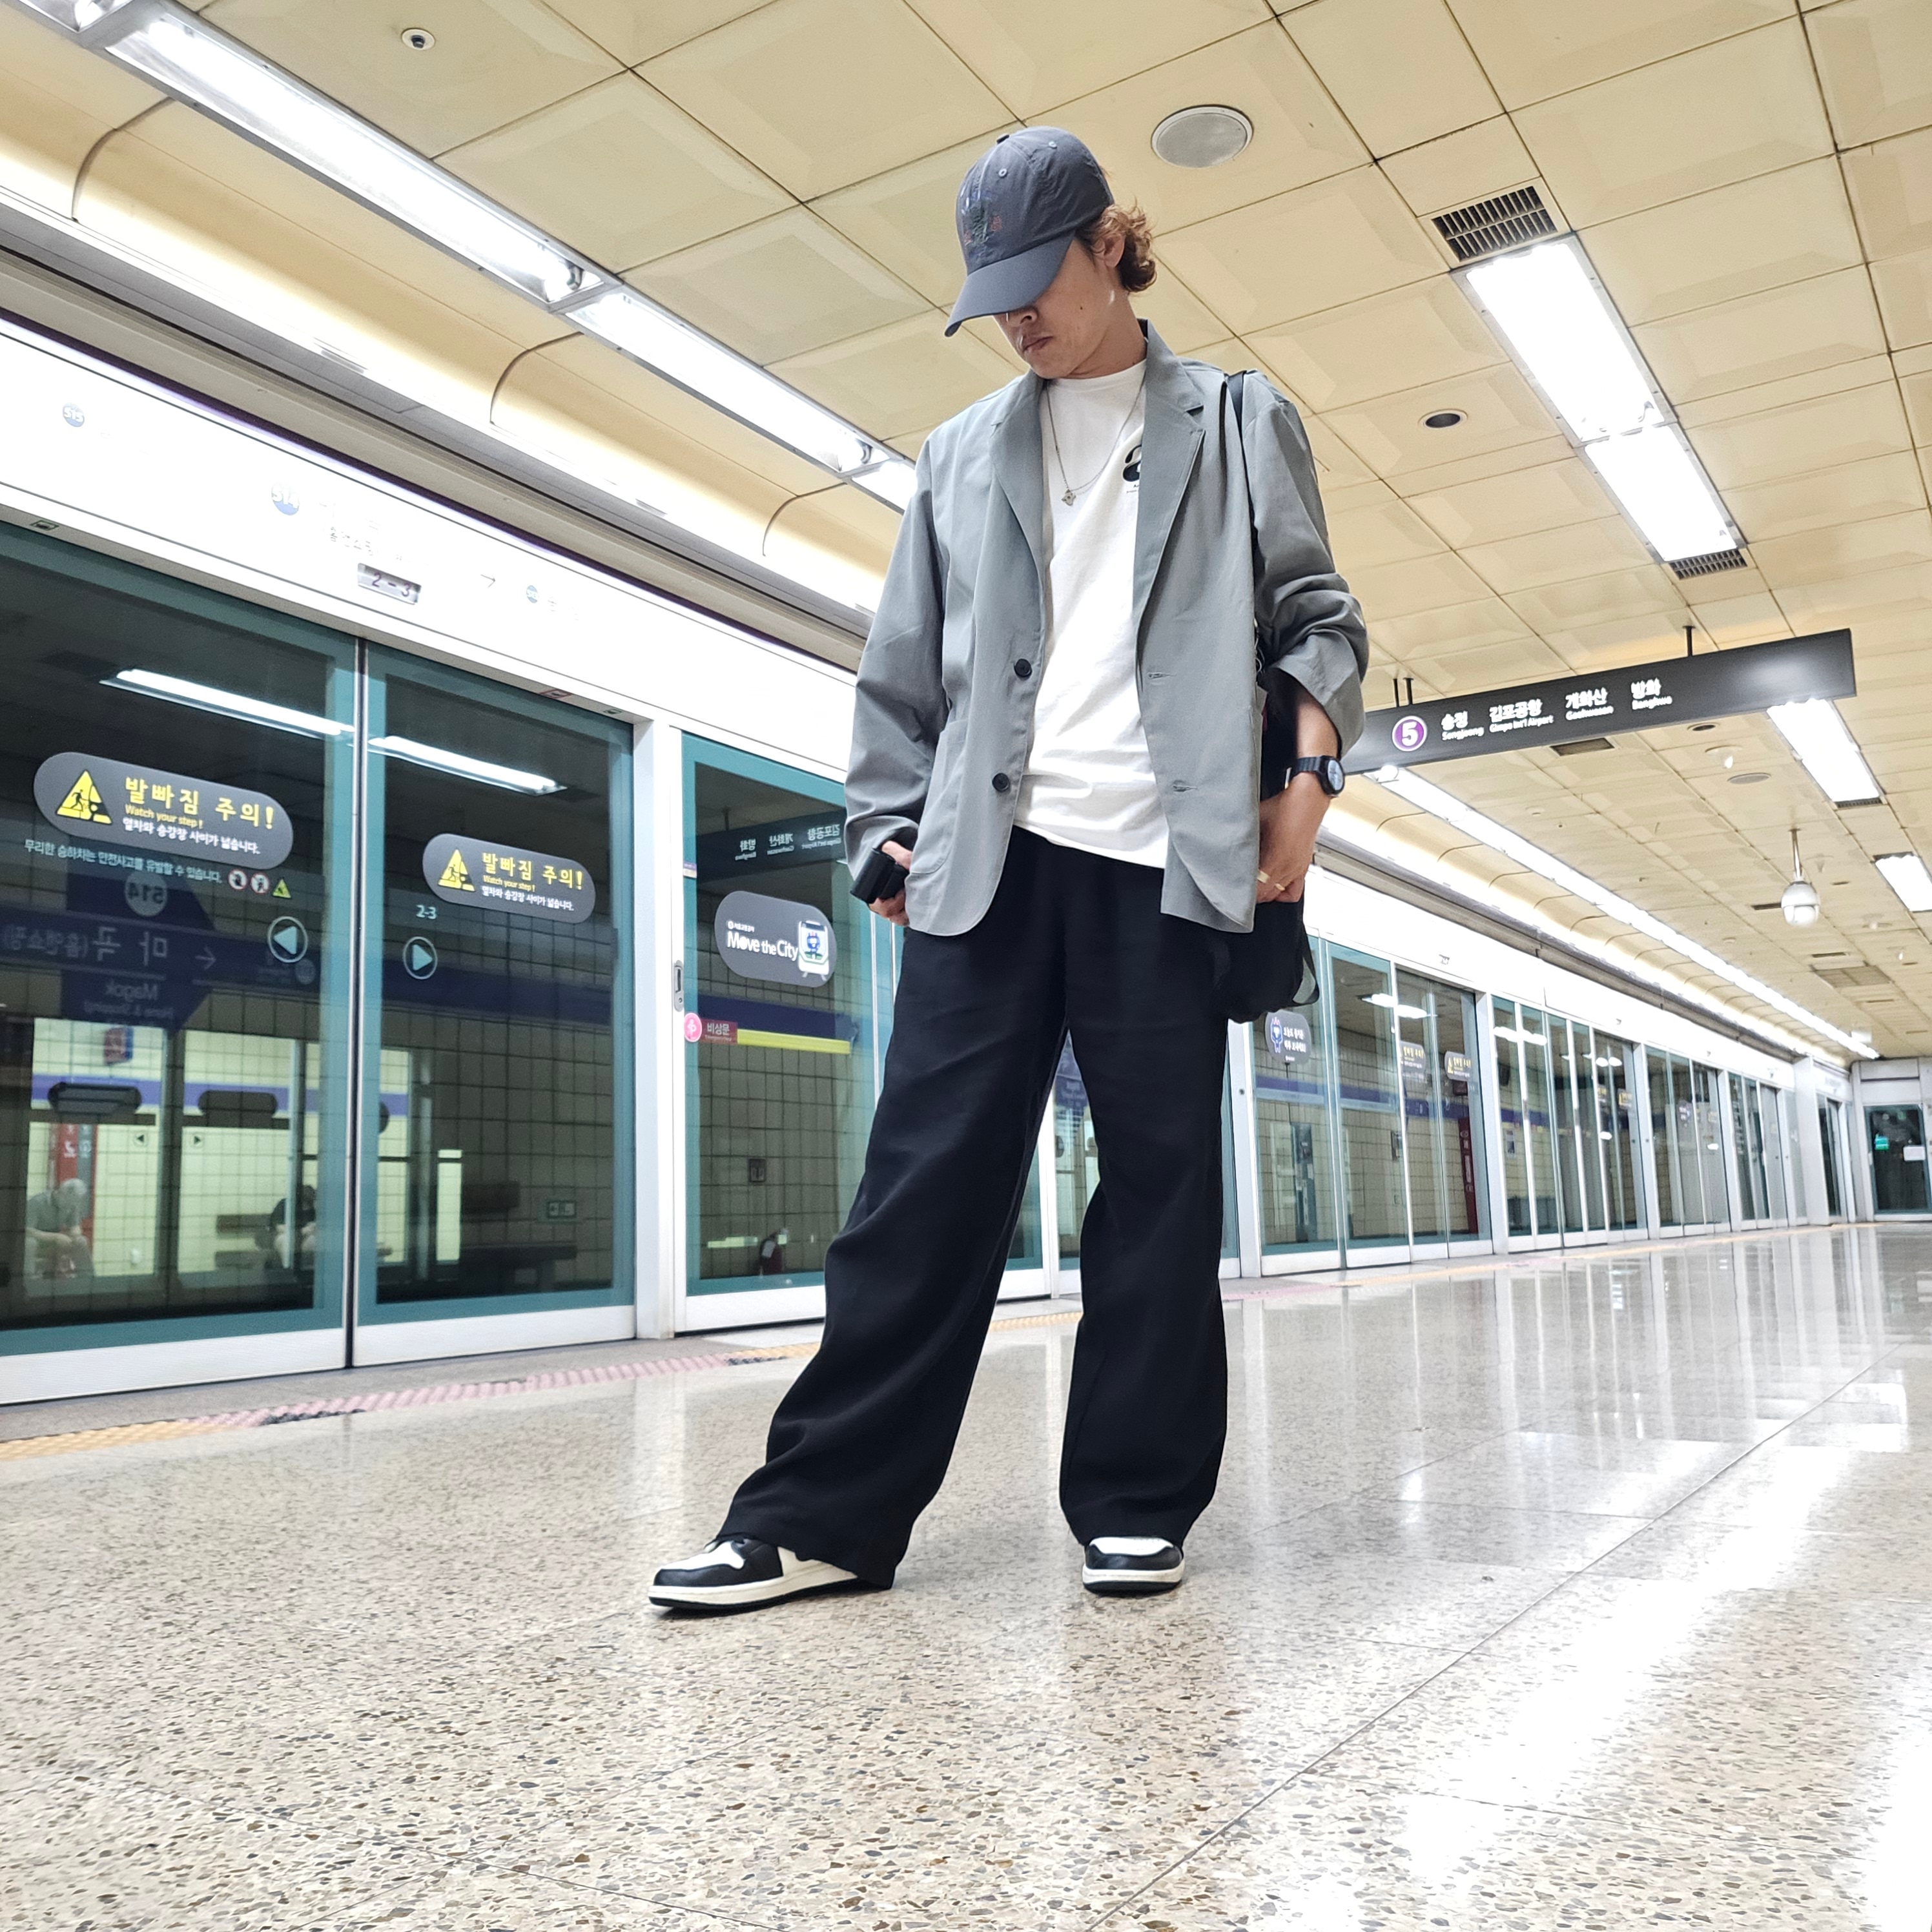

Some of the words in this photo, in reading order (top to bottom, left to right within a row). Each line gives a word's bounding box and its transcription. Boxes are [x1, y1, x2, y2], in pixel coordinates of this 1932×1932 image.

[1441, 711, 1468, 730] 송정
[1489, 698, 1543, 723] 김포공항
[1565, 687, 1608, 709] 개화산
[1631, 677, 1661, 699] 방화
[1401, 721, 1419, 746] 5
[125, 777, 199, 816] 발빠짐
[215, 797, 274, 829] 주의!
[125, 804, 155, 819] Watch
[156, 812, 177, 823] your
[123, 817, 154, 834] 열차와
[157, 824, 188, 841] 승강장
[189, 830, 219, 847] 사이가
[25, 839, 55, 856] 무리한
[174, 865, 184, 877] 수
[482, 852, 531, 881] 발빠짐
[543, 865, 582, 890] 주의!
[483, 874, 503, 885] Watch
[504, 879, 517, 888] your
[416, 905, 436, 920] 2-3
[727, 930, 760, 952] Move
[761, 940, 776, 955] the
[777, 940, 799, 961] City
[706, 1022, 730, 1036] 비상문
